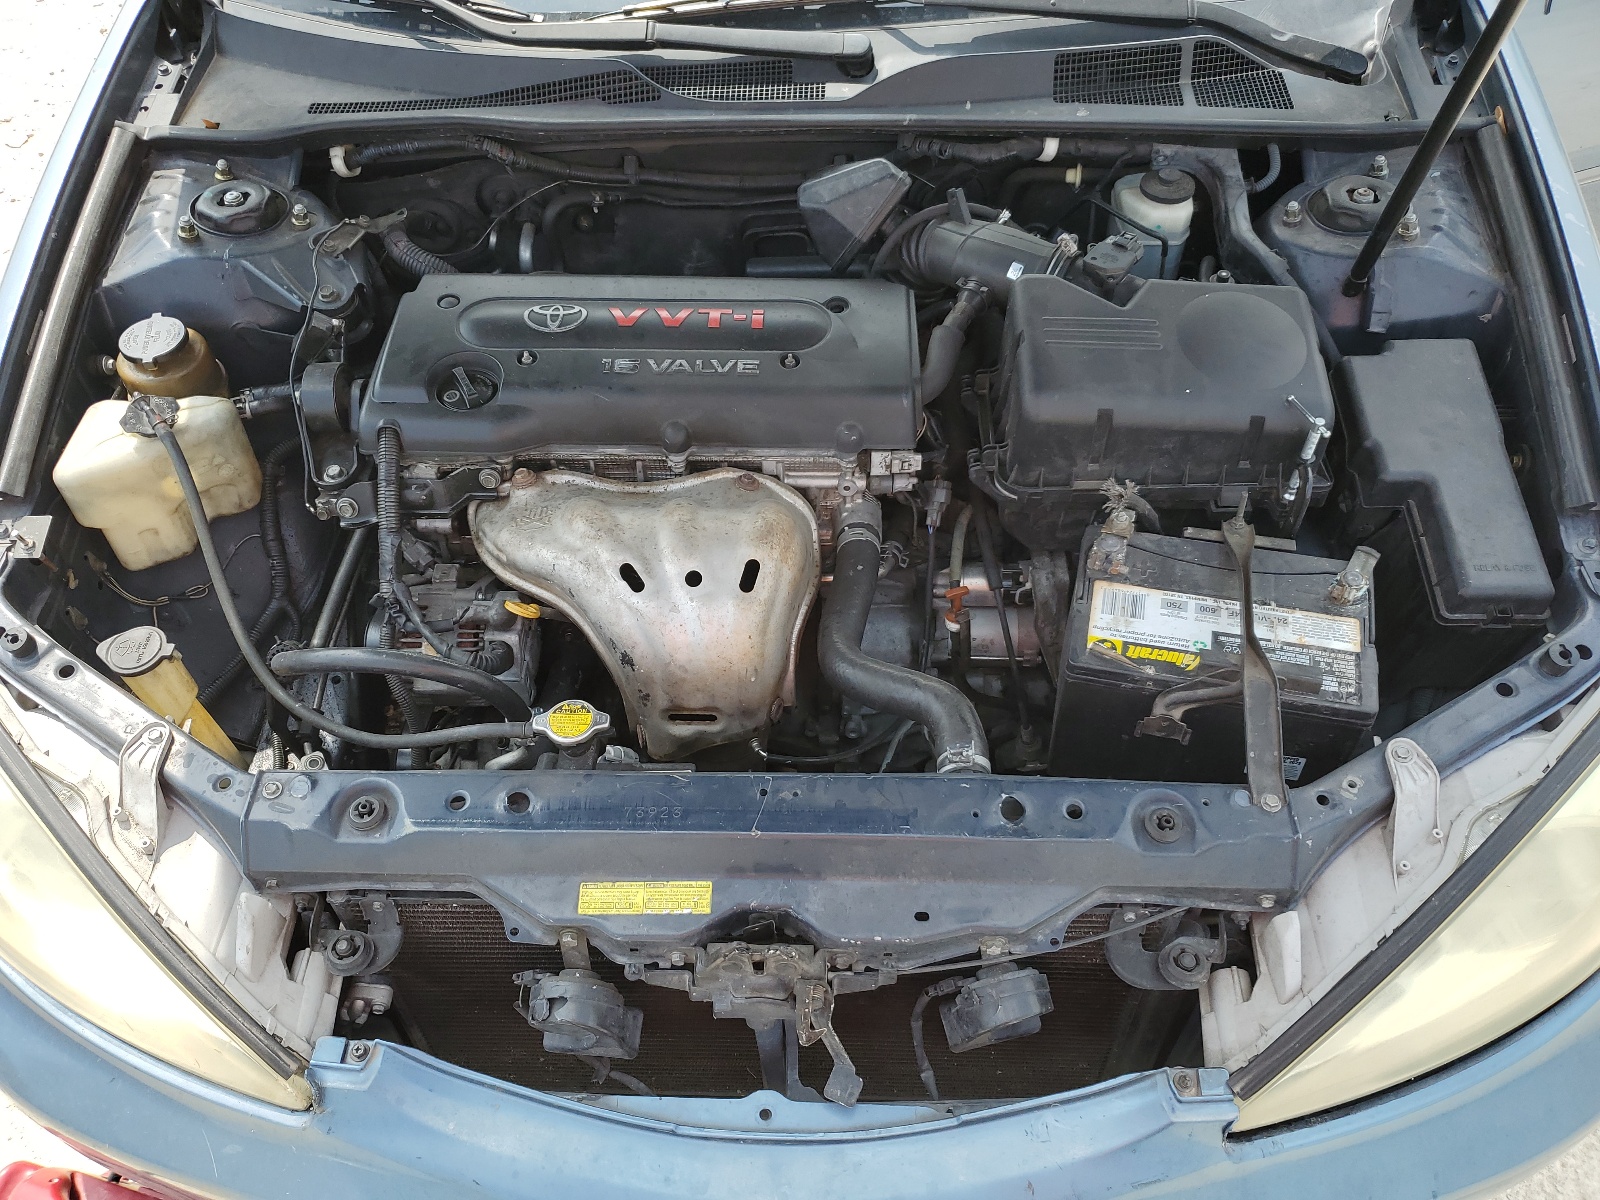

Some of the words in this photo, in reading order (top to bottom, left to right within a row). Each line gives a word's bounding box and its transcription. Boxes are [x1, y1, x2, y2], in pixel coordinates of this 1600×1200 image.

[608, 308, 765, 329] VVT-i
[602, 358, 640, 374] 16
[647, 358, 760, 375] VALVE
[1166, 600, 1183, 610] 750
[1199, 605, 1216, 615] 600
[1123, 628, 1146, 638] proper
[1146, 632, 1156, 640] for
[1149, 638, 1165, 646] used
[1157, 634, 1191, 644] AutoZone
[1168, 641, 1190, 649] Return
[1126, 644, 1200, 671] Valucraft
[624, 806, 682, 818] 73923
